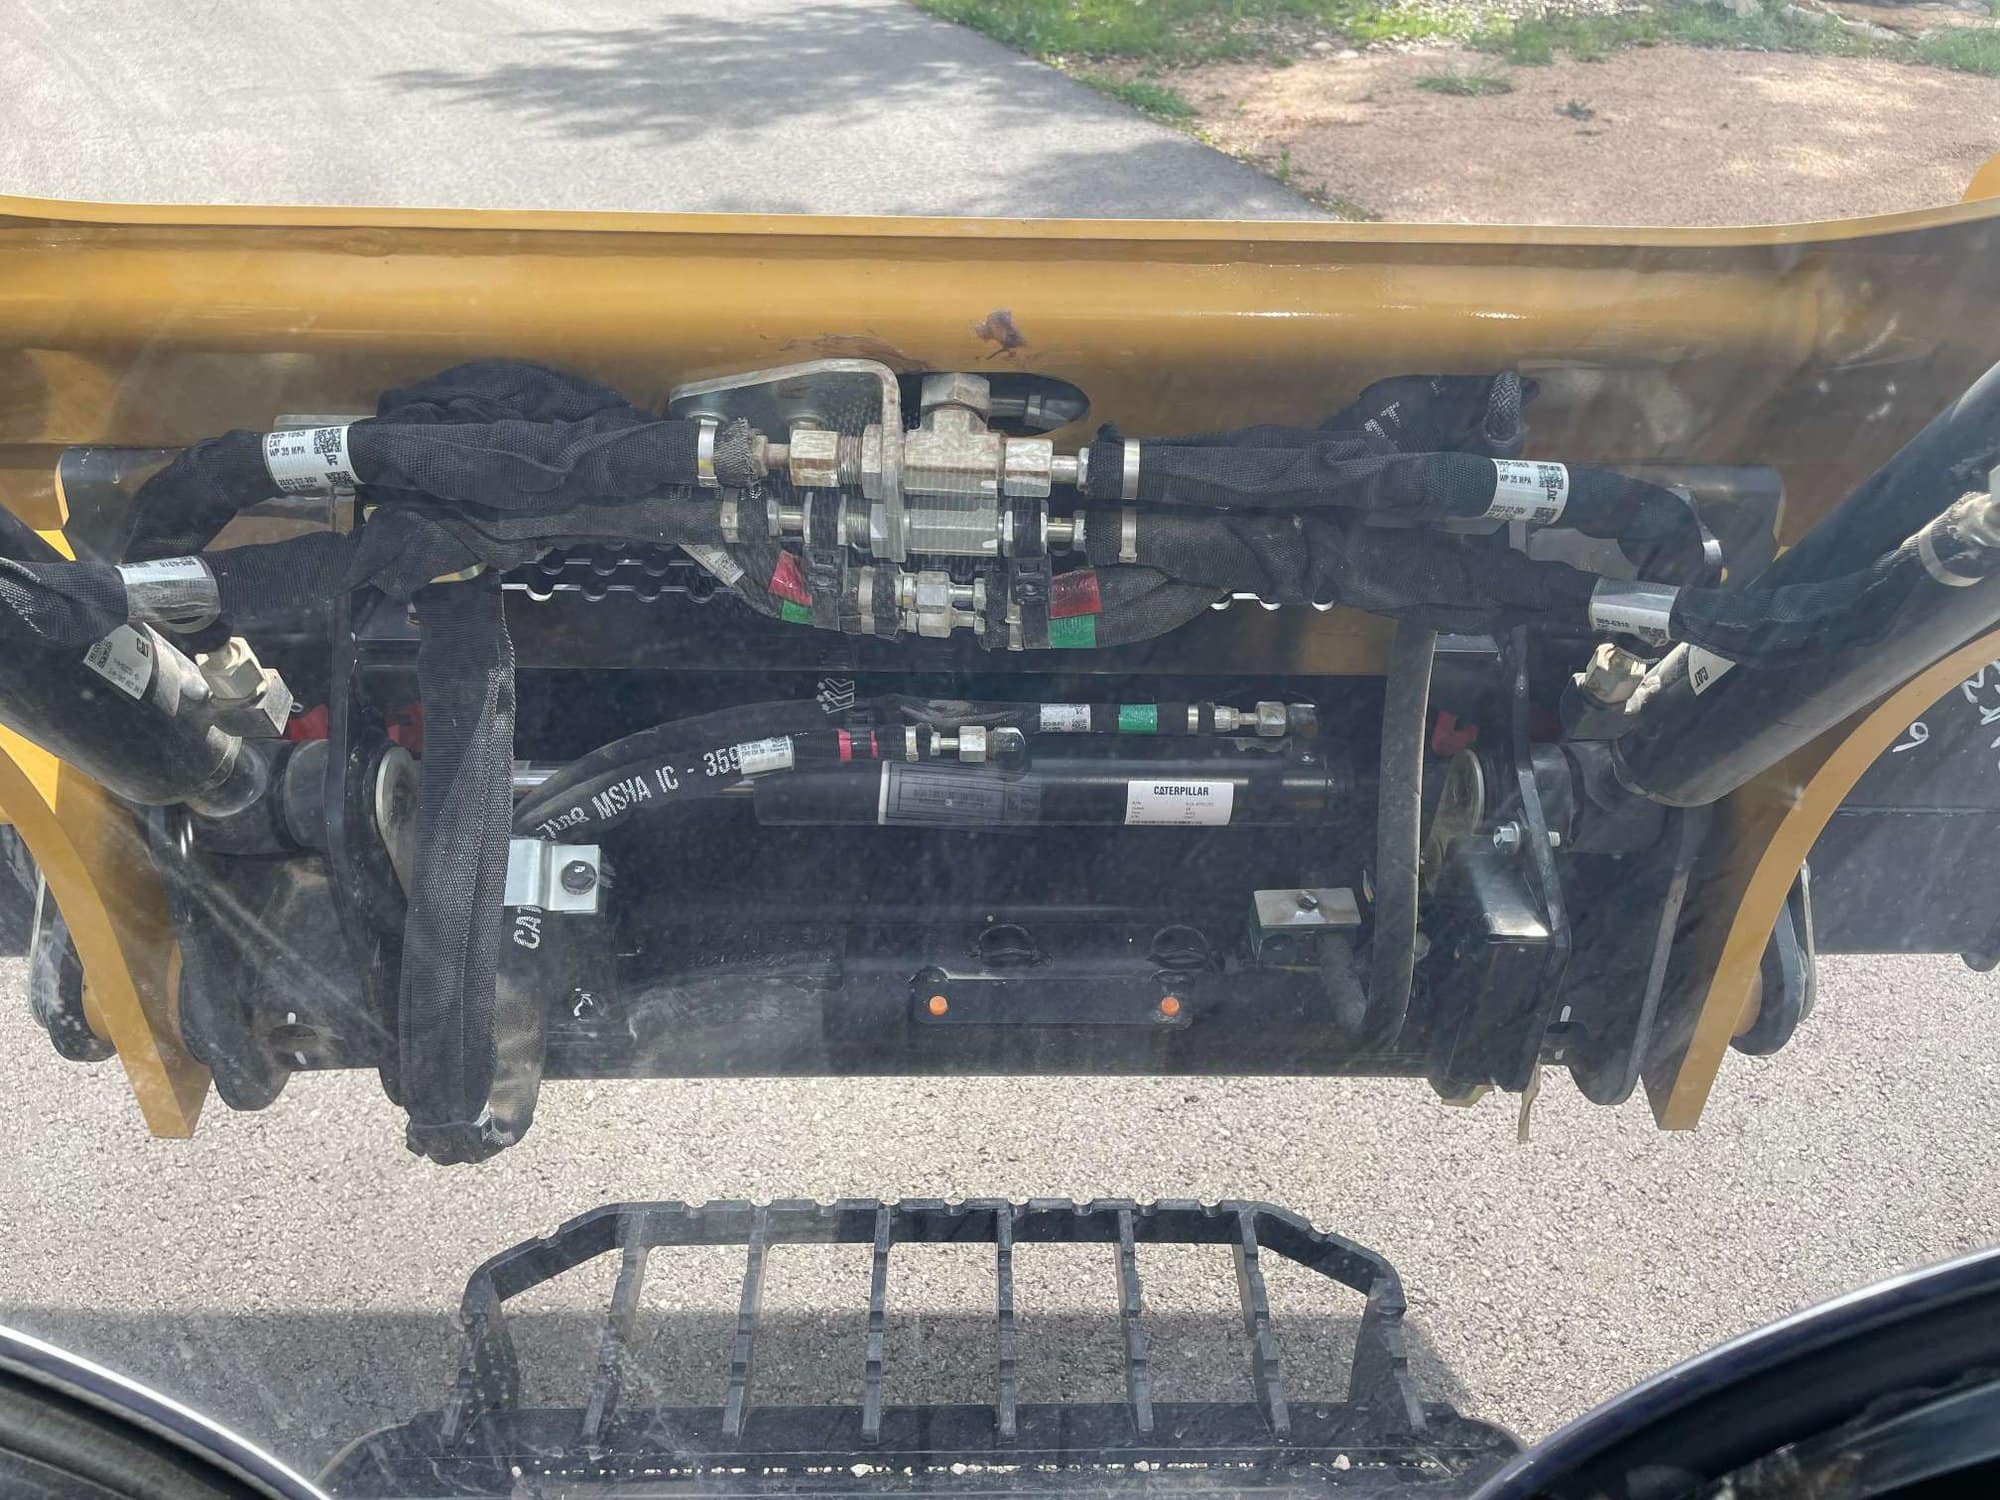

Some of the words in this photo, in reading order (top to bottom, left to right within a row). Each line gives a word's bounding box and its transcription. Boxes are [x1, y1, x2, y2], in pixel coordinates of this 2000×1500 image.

[1694, 666, 1709, 688] CAT
[591, 775, 652, 820] MSHA
[655, 765, 679, 793] IC
[1153, 785, 1209, 797] CATERPILLAR
